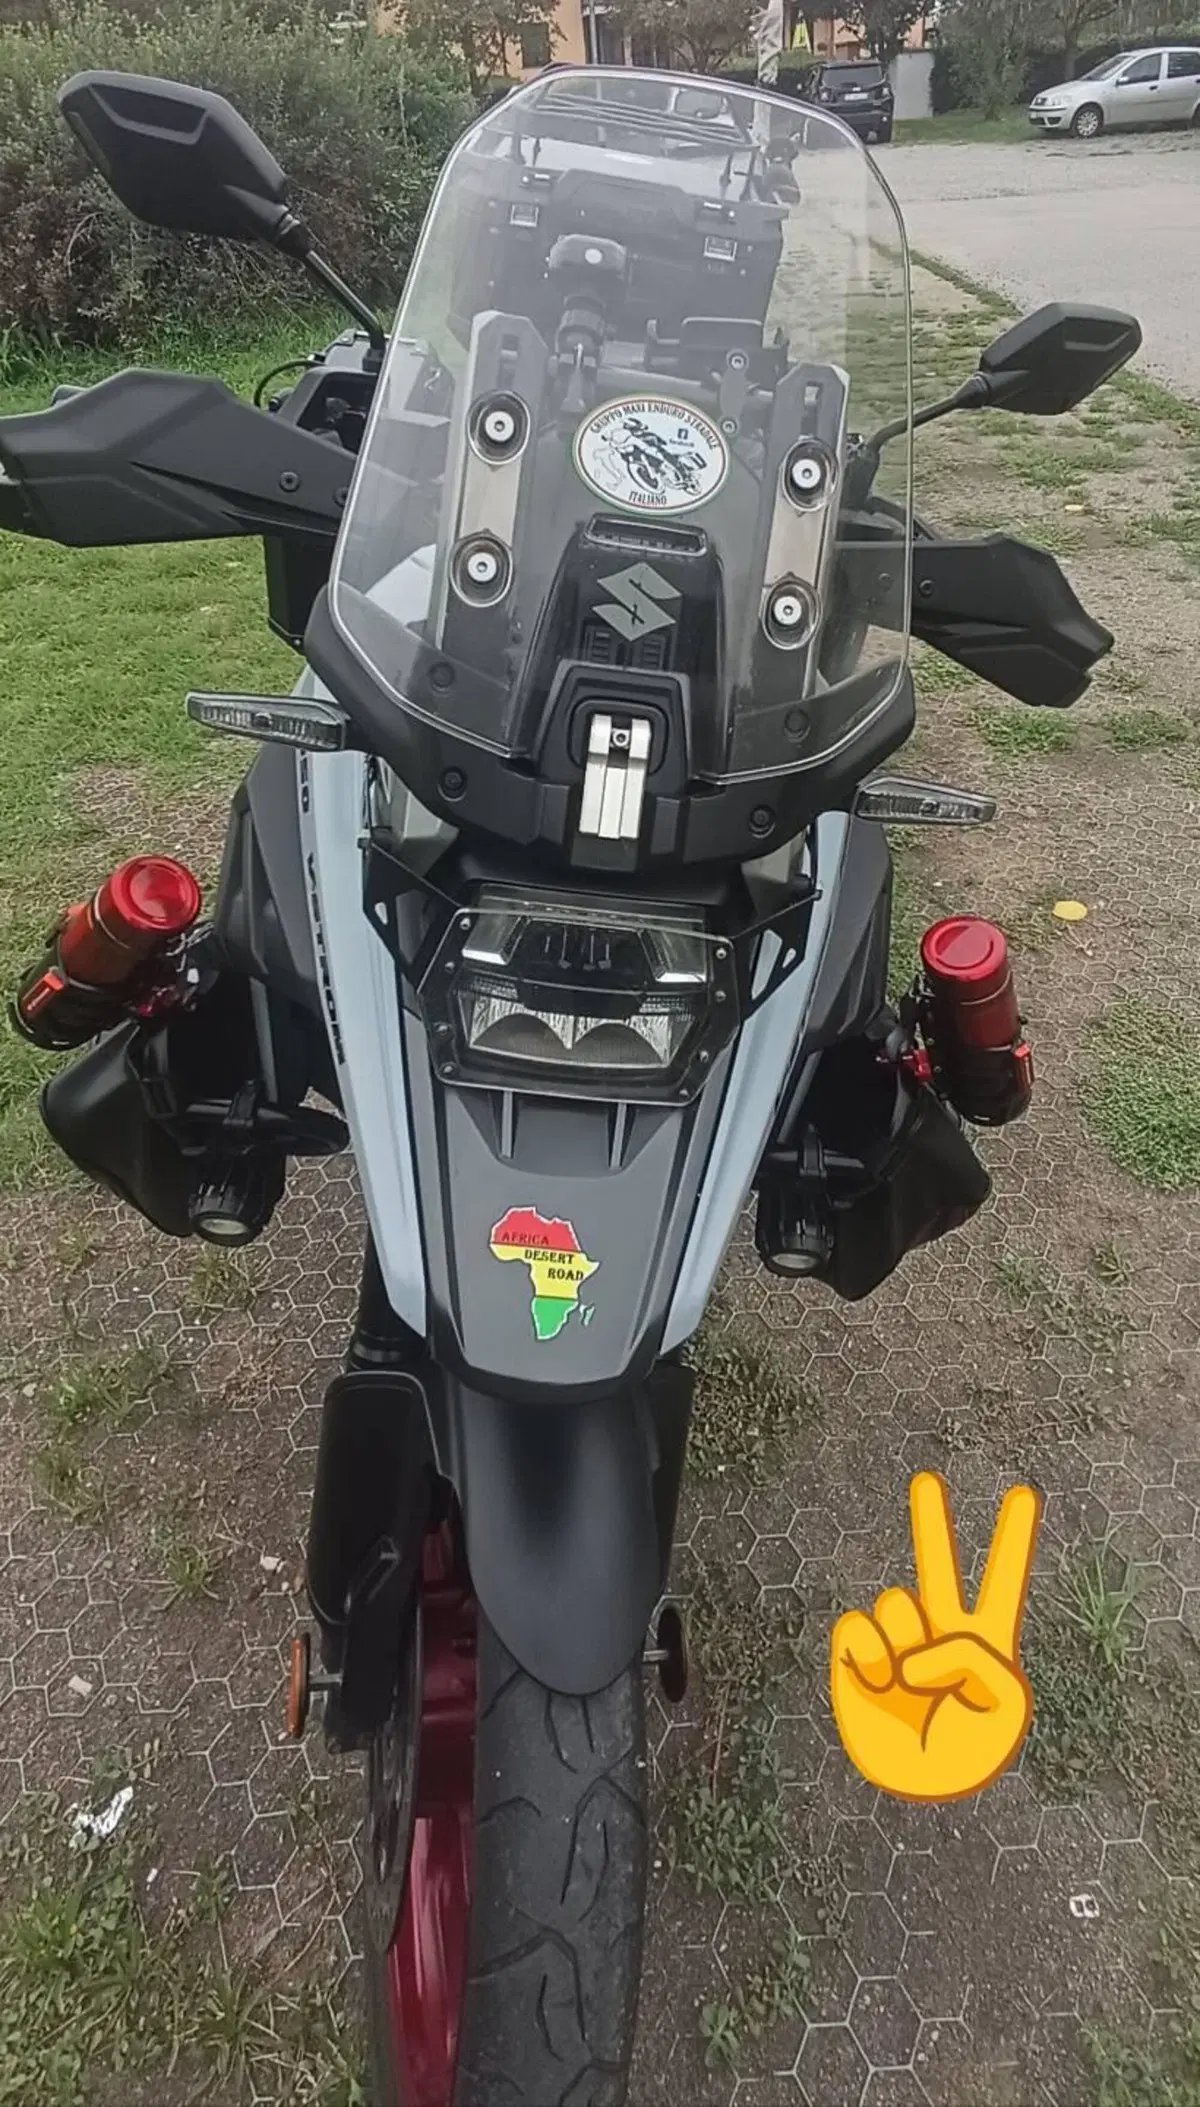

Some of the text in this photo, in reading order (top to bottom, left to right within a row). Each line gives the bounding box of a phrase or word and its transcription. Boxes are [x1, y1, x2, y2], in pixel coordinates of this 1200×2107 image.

[590, 409, 623, 433] GRUPPO
[622, 403, 646, 415] MAXI
[647, 403, 685, 419] ENDURO
[629, 491, 668, 505] ITALIANO
[501, 1231, 549, 1245] AFRICA
[524, 1249, 575, 1264] DESERT
[547, 1267, 584, 1281] ROAD
